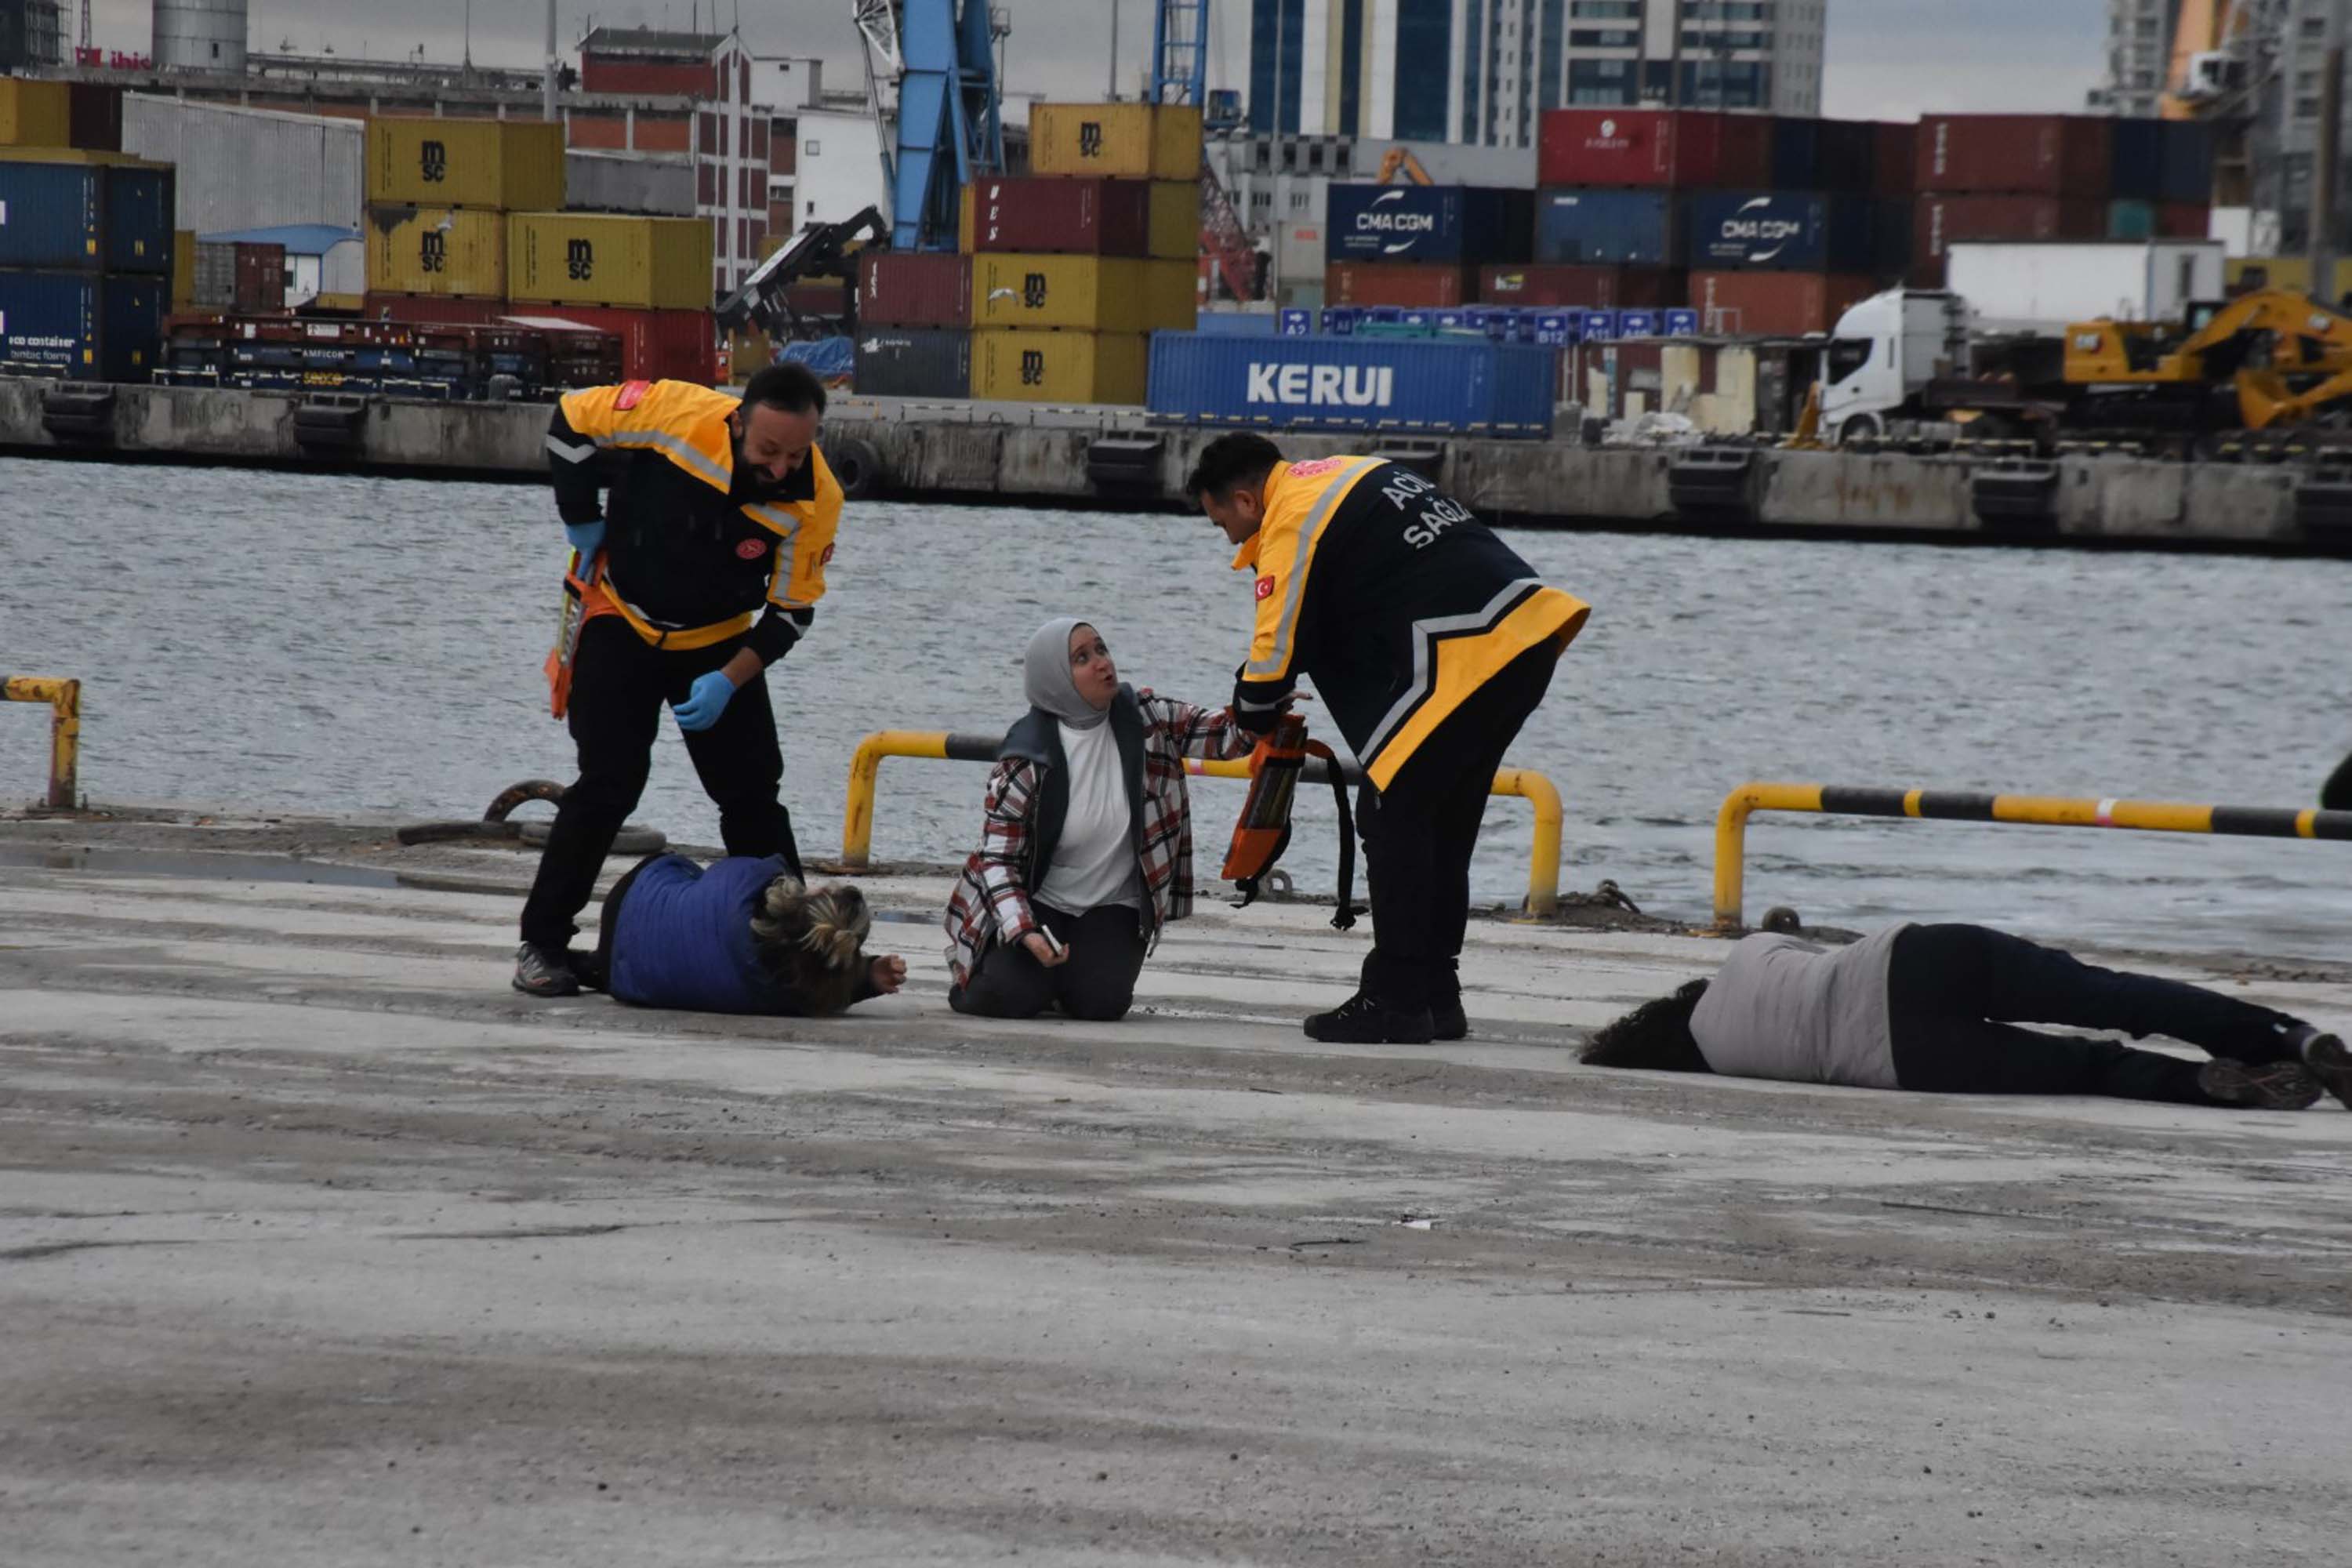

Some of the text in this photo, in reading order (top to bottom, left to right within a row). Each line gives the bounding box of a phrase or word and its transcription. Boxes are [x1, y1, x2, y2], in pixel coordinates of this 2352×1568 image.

[1356, 212, 1433, 231] CMA CGM
[1721, 220, 1800, 238] CMA CGM
[27, 336, 75, 347] container
[1537, 331, 1565, 344] B12
[1247, 363, 1392, 406] KERUI
[1381, 470, 1436, 511] ACİL
